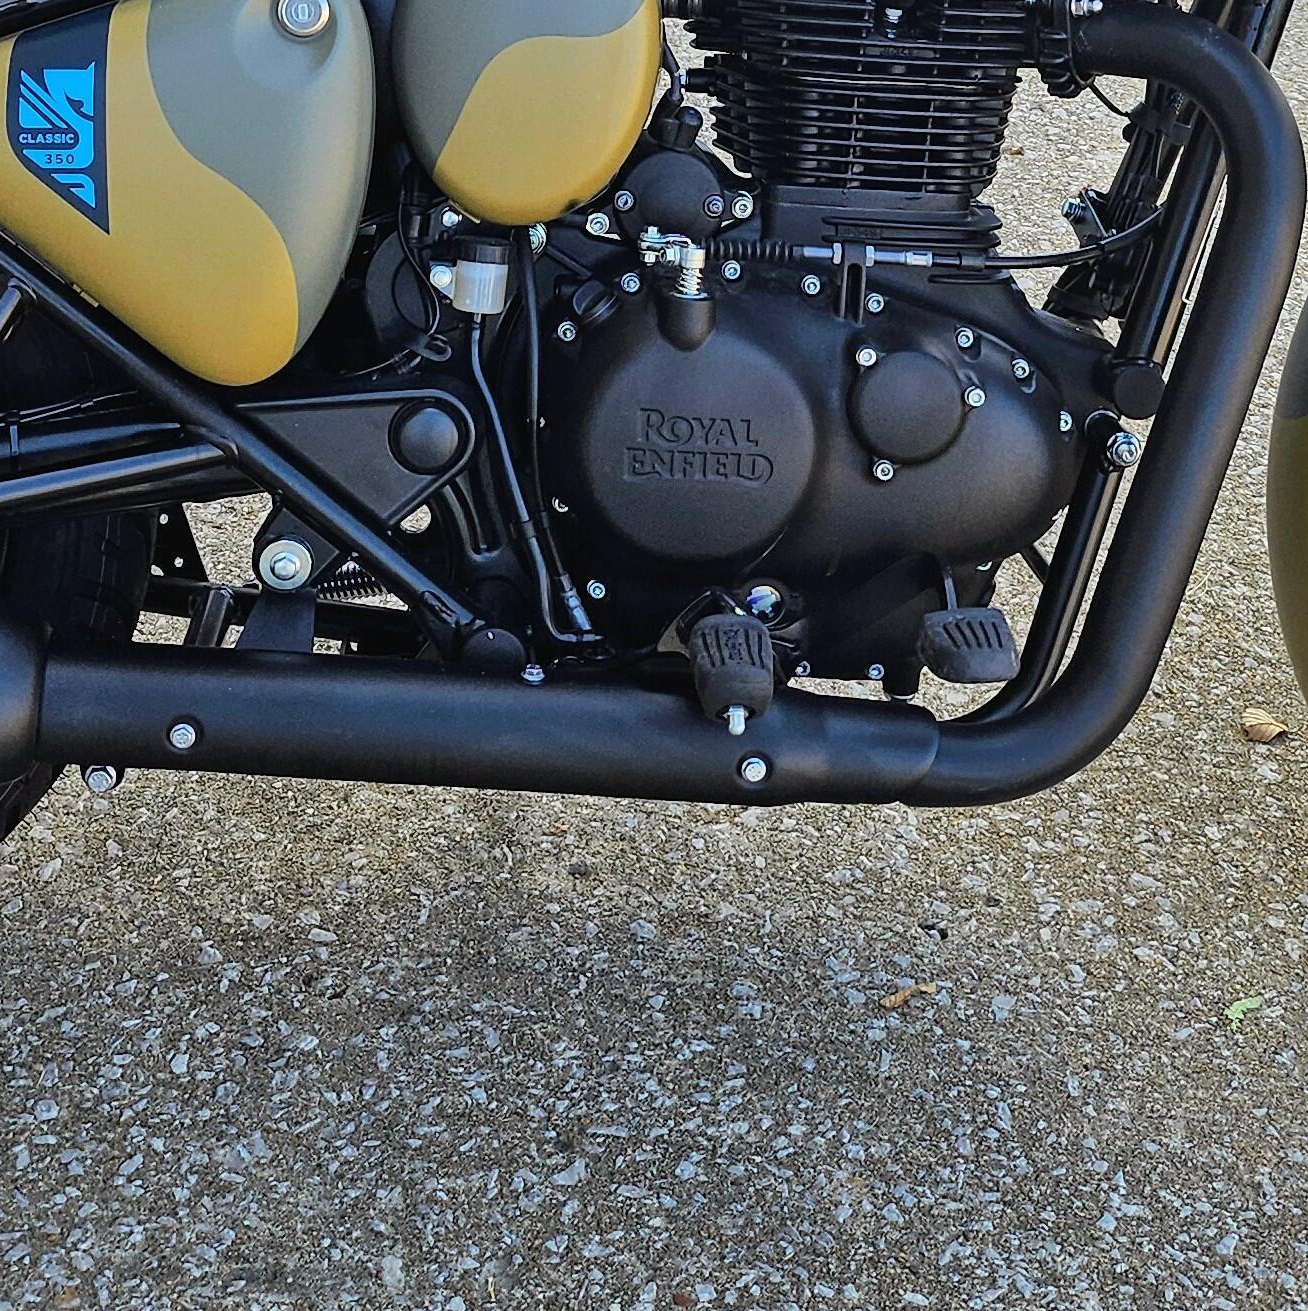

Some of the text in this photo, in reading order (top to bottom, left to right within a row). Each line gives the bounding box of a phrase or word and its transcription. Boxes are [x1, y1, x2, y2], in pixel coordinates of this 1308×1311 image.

[18, 133, 75, 145] CLASSIC
[44, 153, 75, 165] 350
[639, 407, 759, 447] ROYAL
[624, 447, 774, 485] ENFIELD
